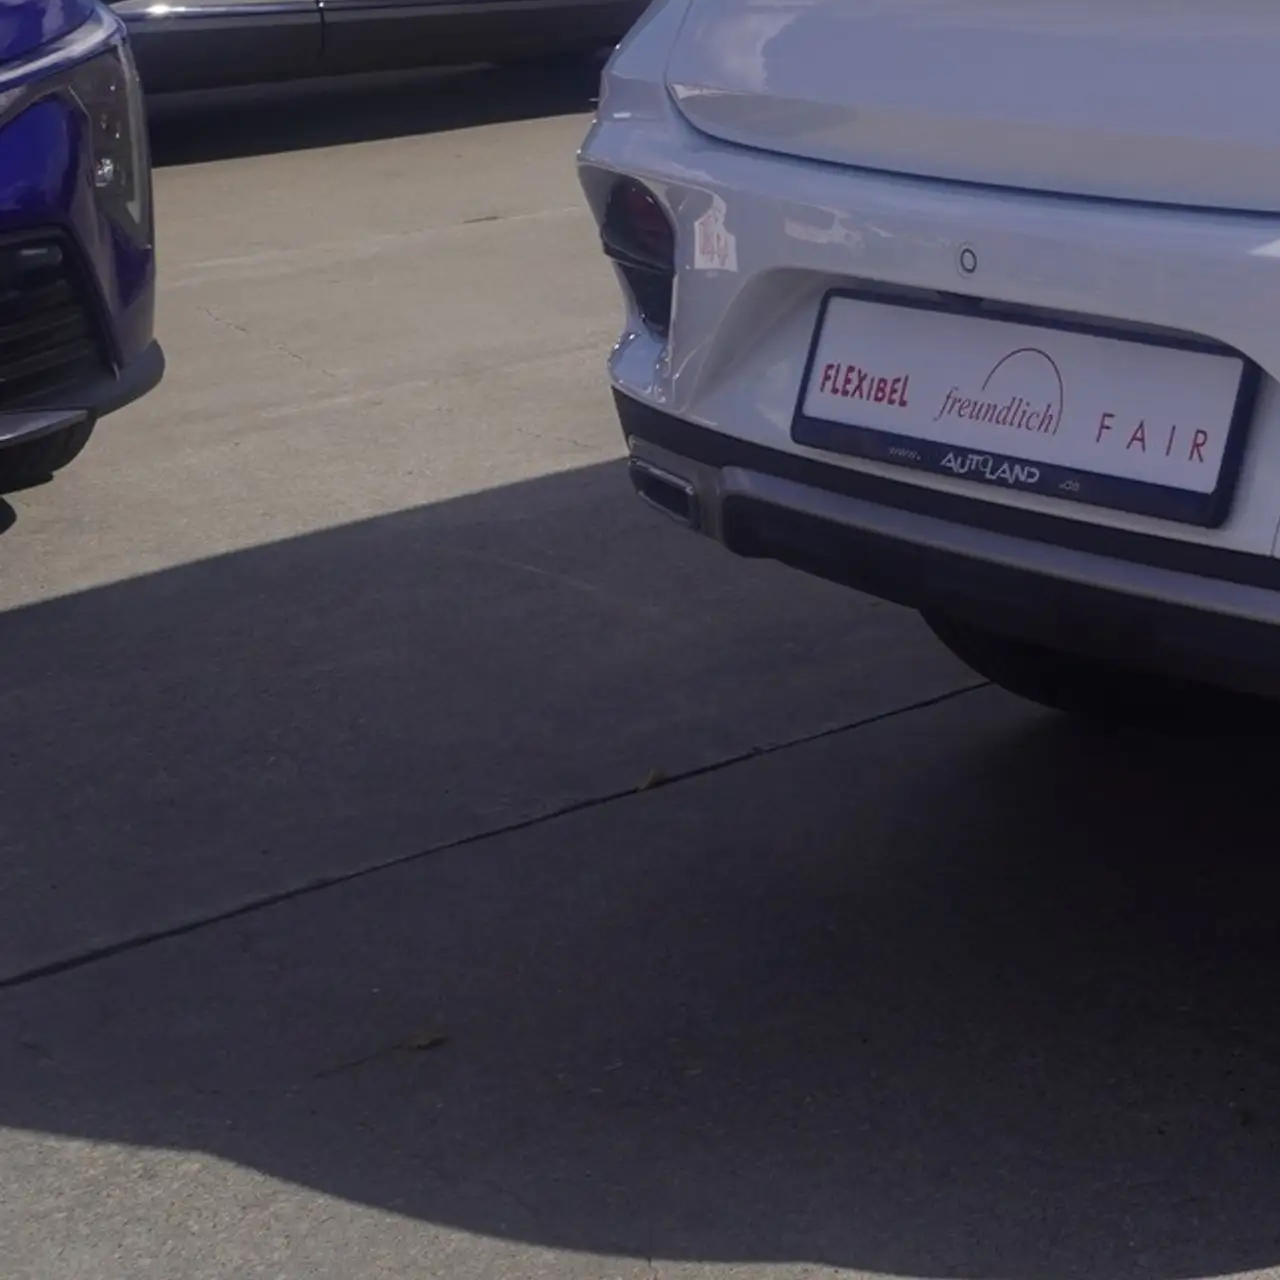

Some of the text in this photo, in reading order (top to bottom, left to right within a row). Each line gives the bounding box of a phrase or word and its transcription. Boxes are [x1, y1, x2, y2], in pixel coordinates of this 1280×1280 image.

[819, 363, 1209, 463] FLEXIBEL freundlich FAIR
[940, 452, 1040, 484] AUTOLAND
